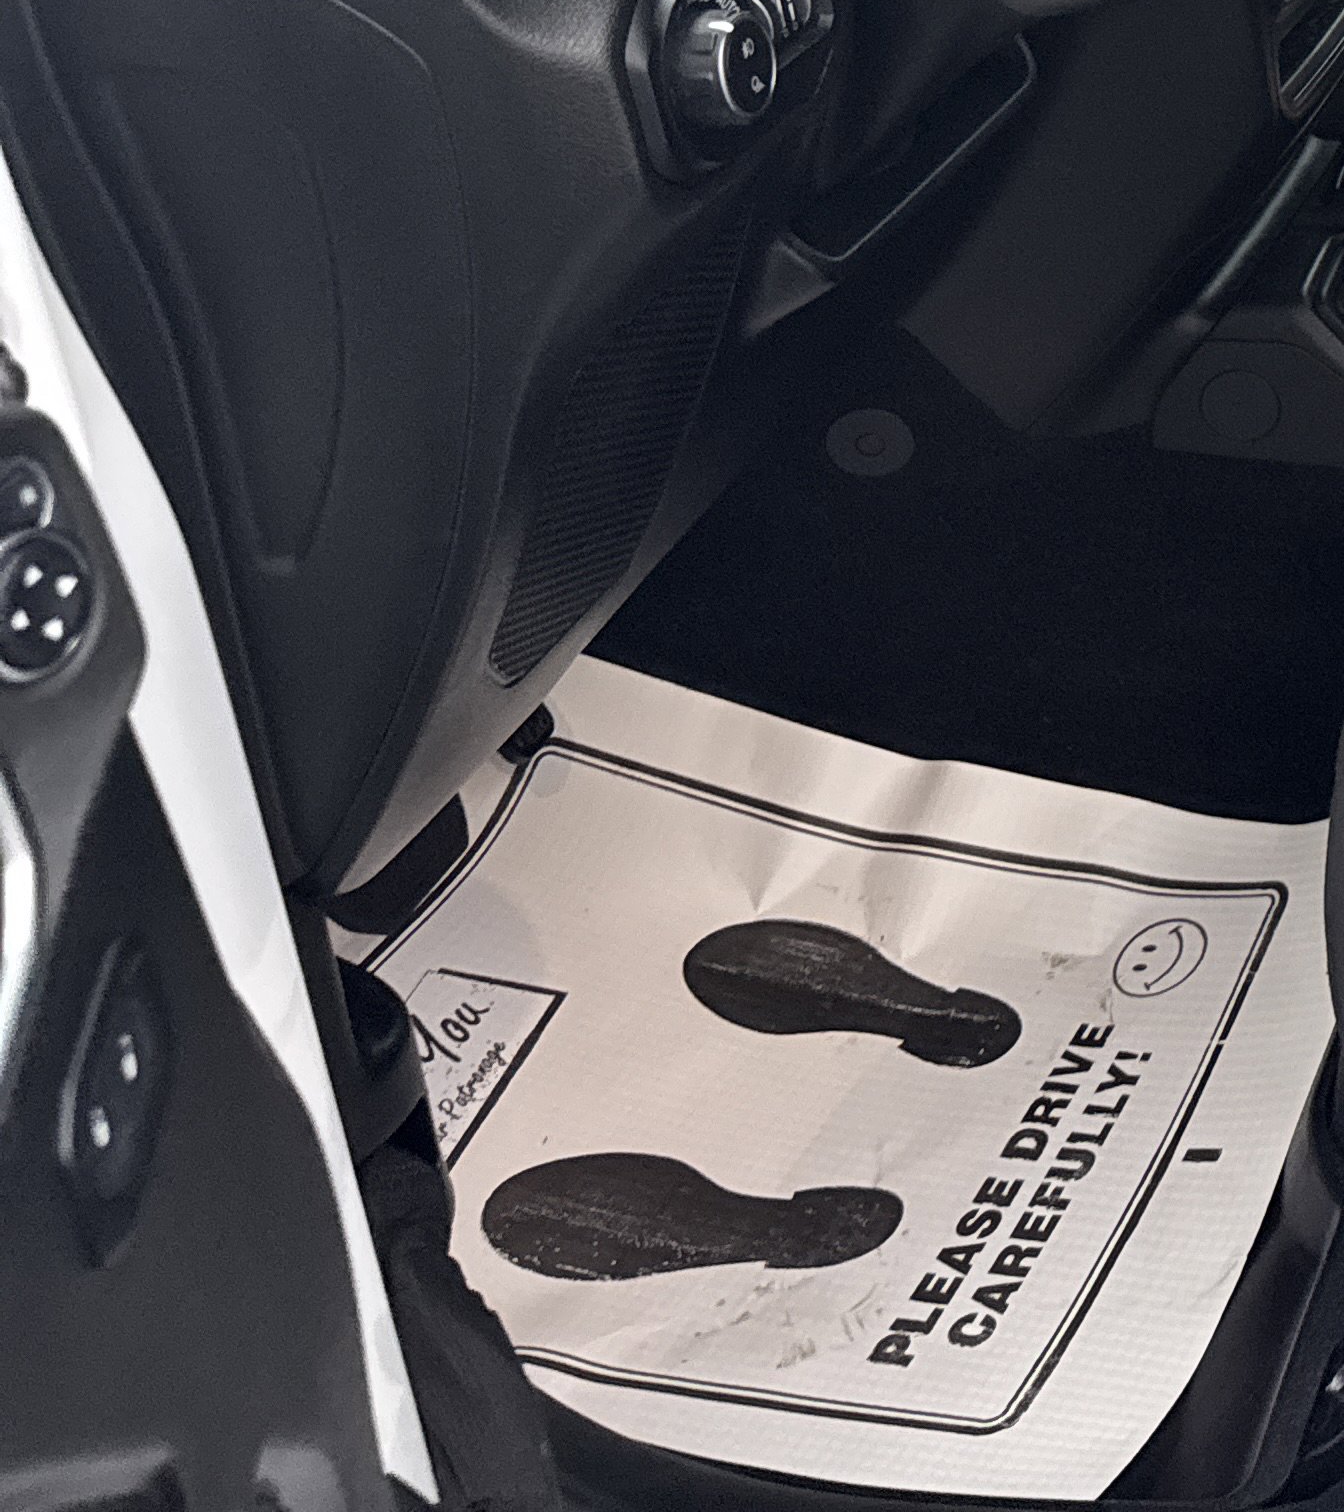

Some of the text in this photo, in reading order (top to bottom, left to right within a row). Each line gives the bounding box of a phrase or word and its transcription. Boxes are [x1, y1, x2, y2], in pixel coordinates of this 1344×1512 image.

[437, 1040, 507, 1122] Patronage
[866, 1022, 1115, 1368] PLEASE DRIVE
[947, 1050, 1153, 1348] CAREFULLY!
